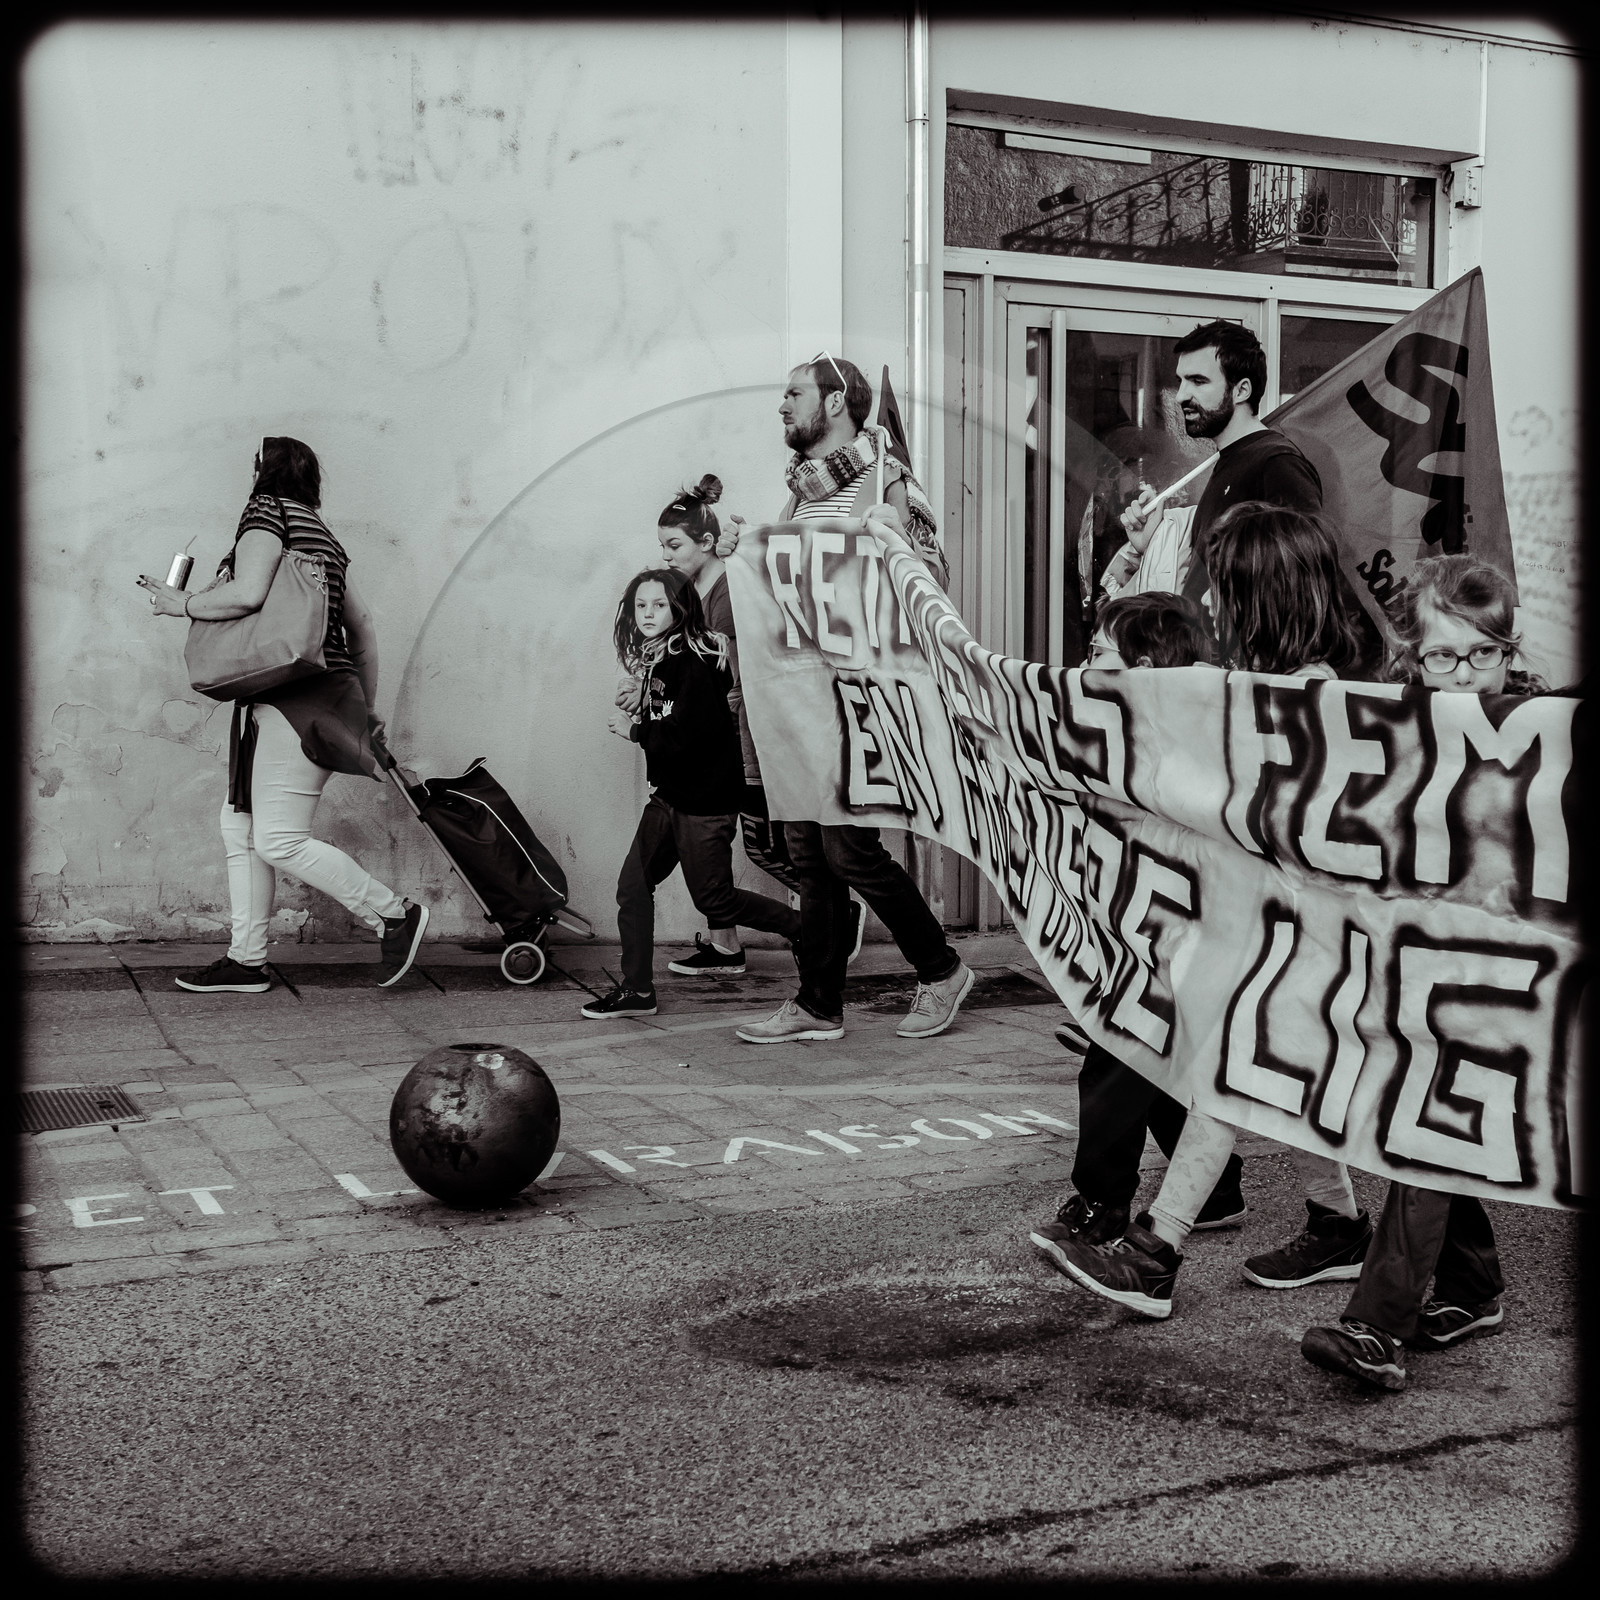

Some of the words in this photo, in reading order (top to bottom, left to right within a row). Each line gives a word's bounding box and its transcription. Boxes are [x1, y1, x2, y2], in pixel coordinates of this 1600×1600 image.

[1224, 670, 1580, 903] FEM
[837, 680, 943, 826] EN
[1225, 918, 1592, 1200] LIG
[12, 1184, 234, 1232] ET
[334, 1108, 1080, 1199] LRAISON
